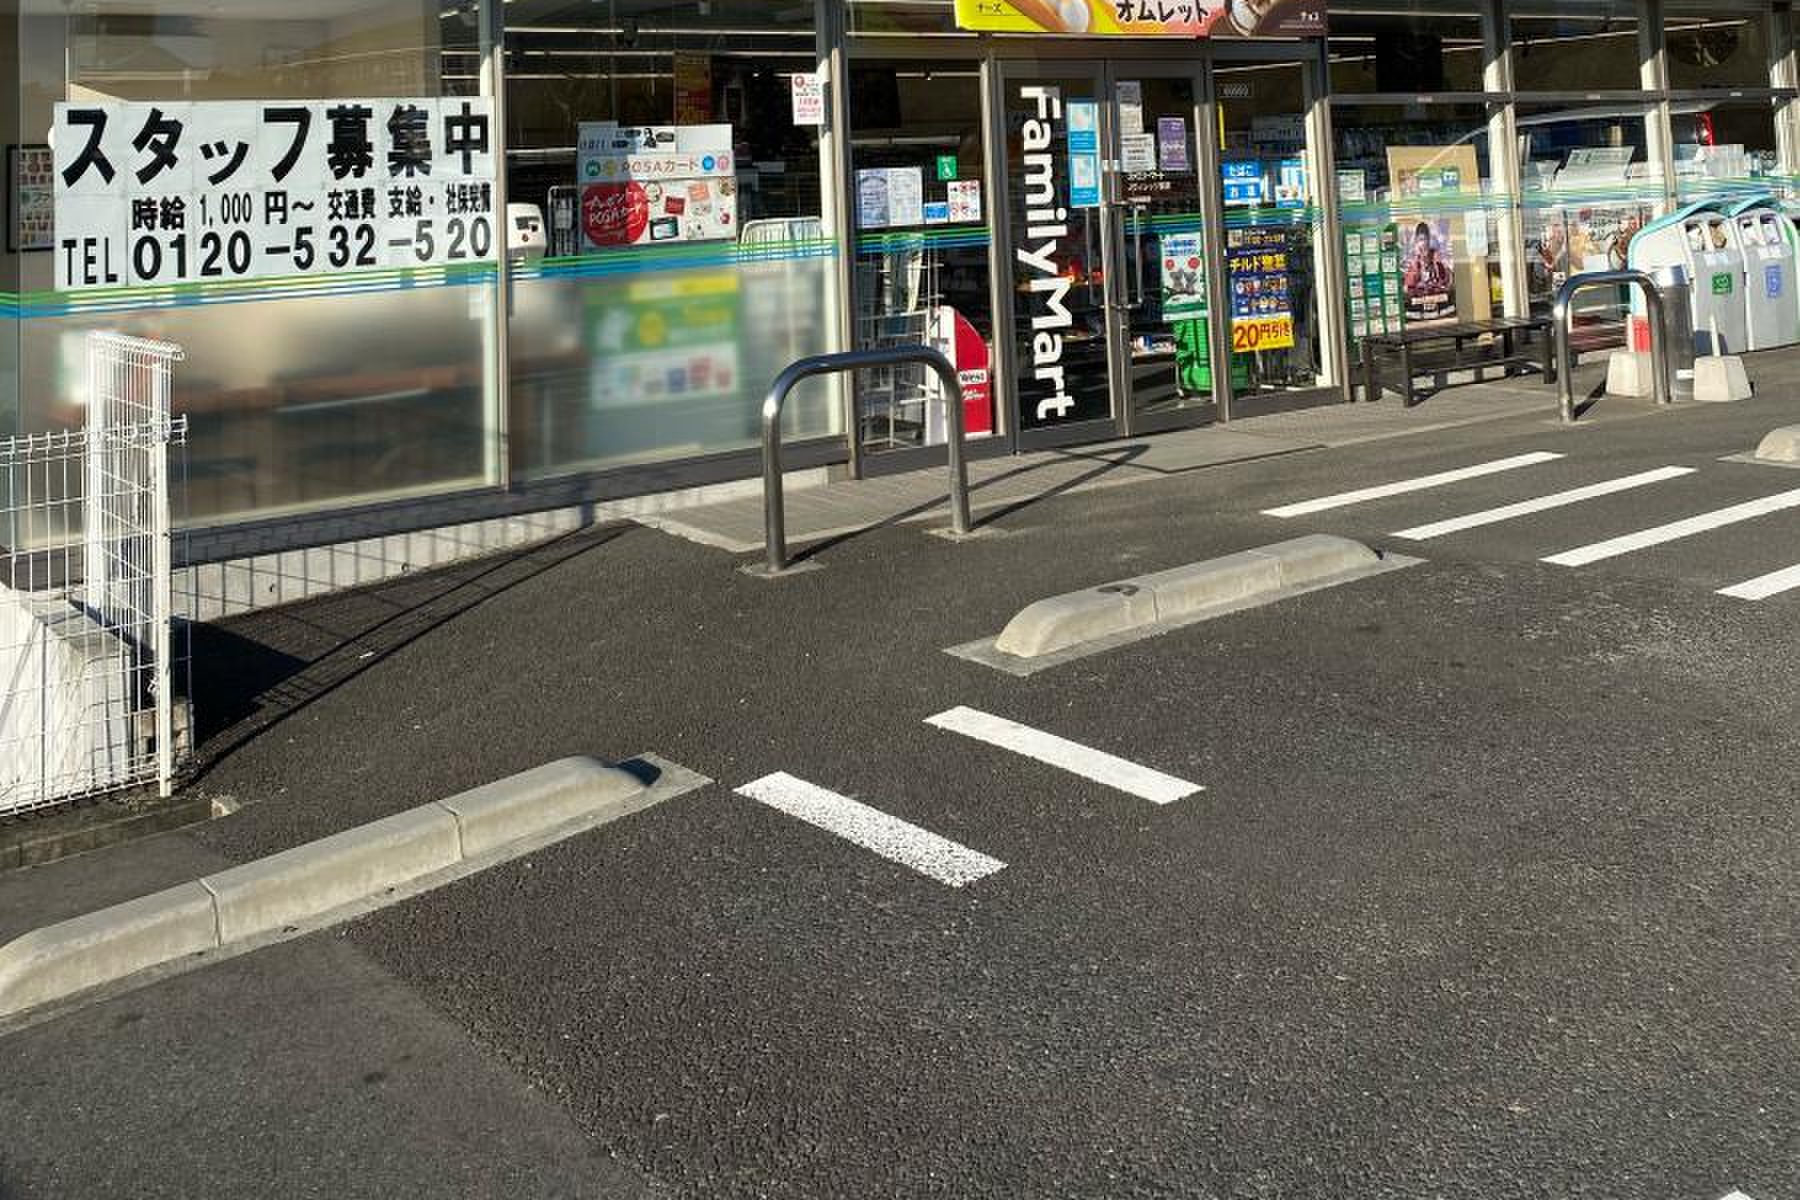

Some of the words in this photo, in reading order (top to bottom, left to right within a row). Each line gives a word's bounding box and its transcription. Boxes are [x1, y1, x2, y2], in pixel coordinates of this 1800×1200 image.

[1116, 0, 1208, 24] オムレット
[62, 101, 489, 188] スタッフ募集中
[132, 196, 186, 230] 時給
[62, 236, 118, 286] TEL
[1017, 86, 1075, 420] FamilyMart
